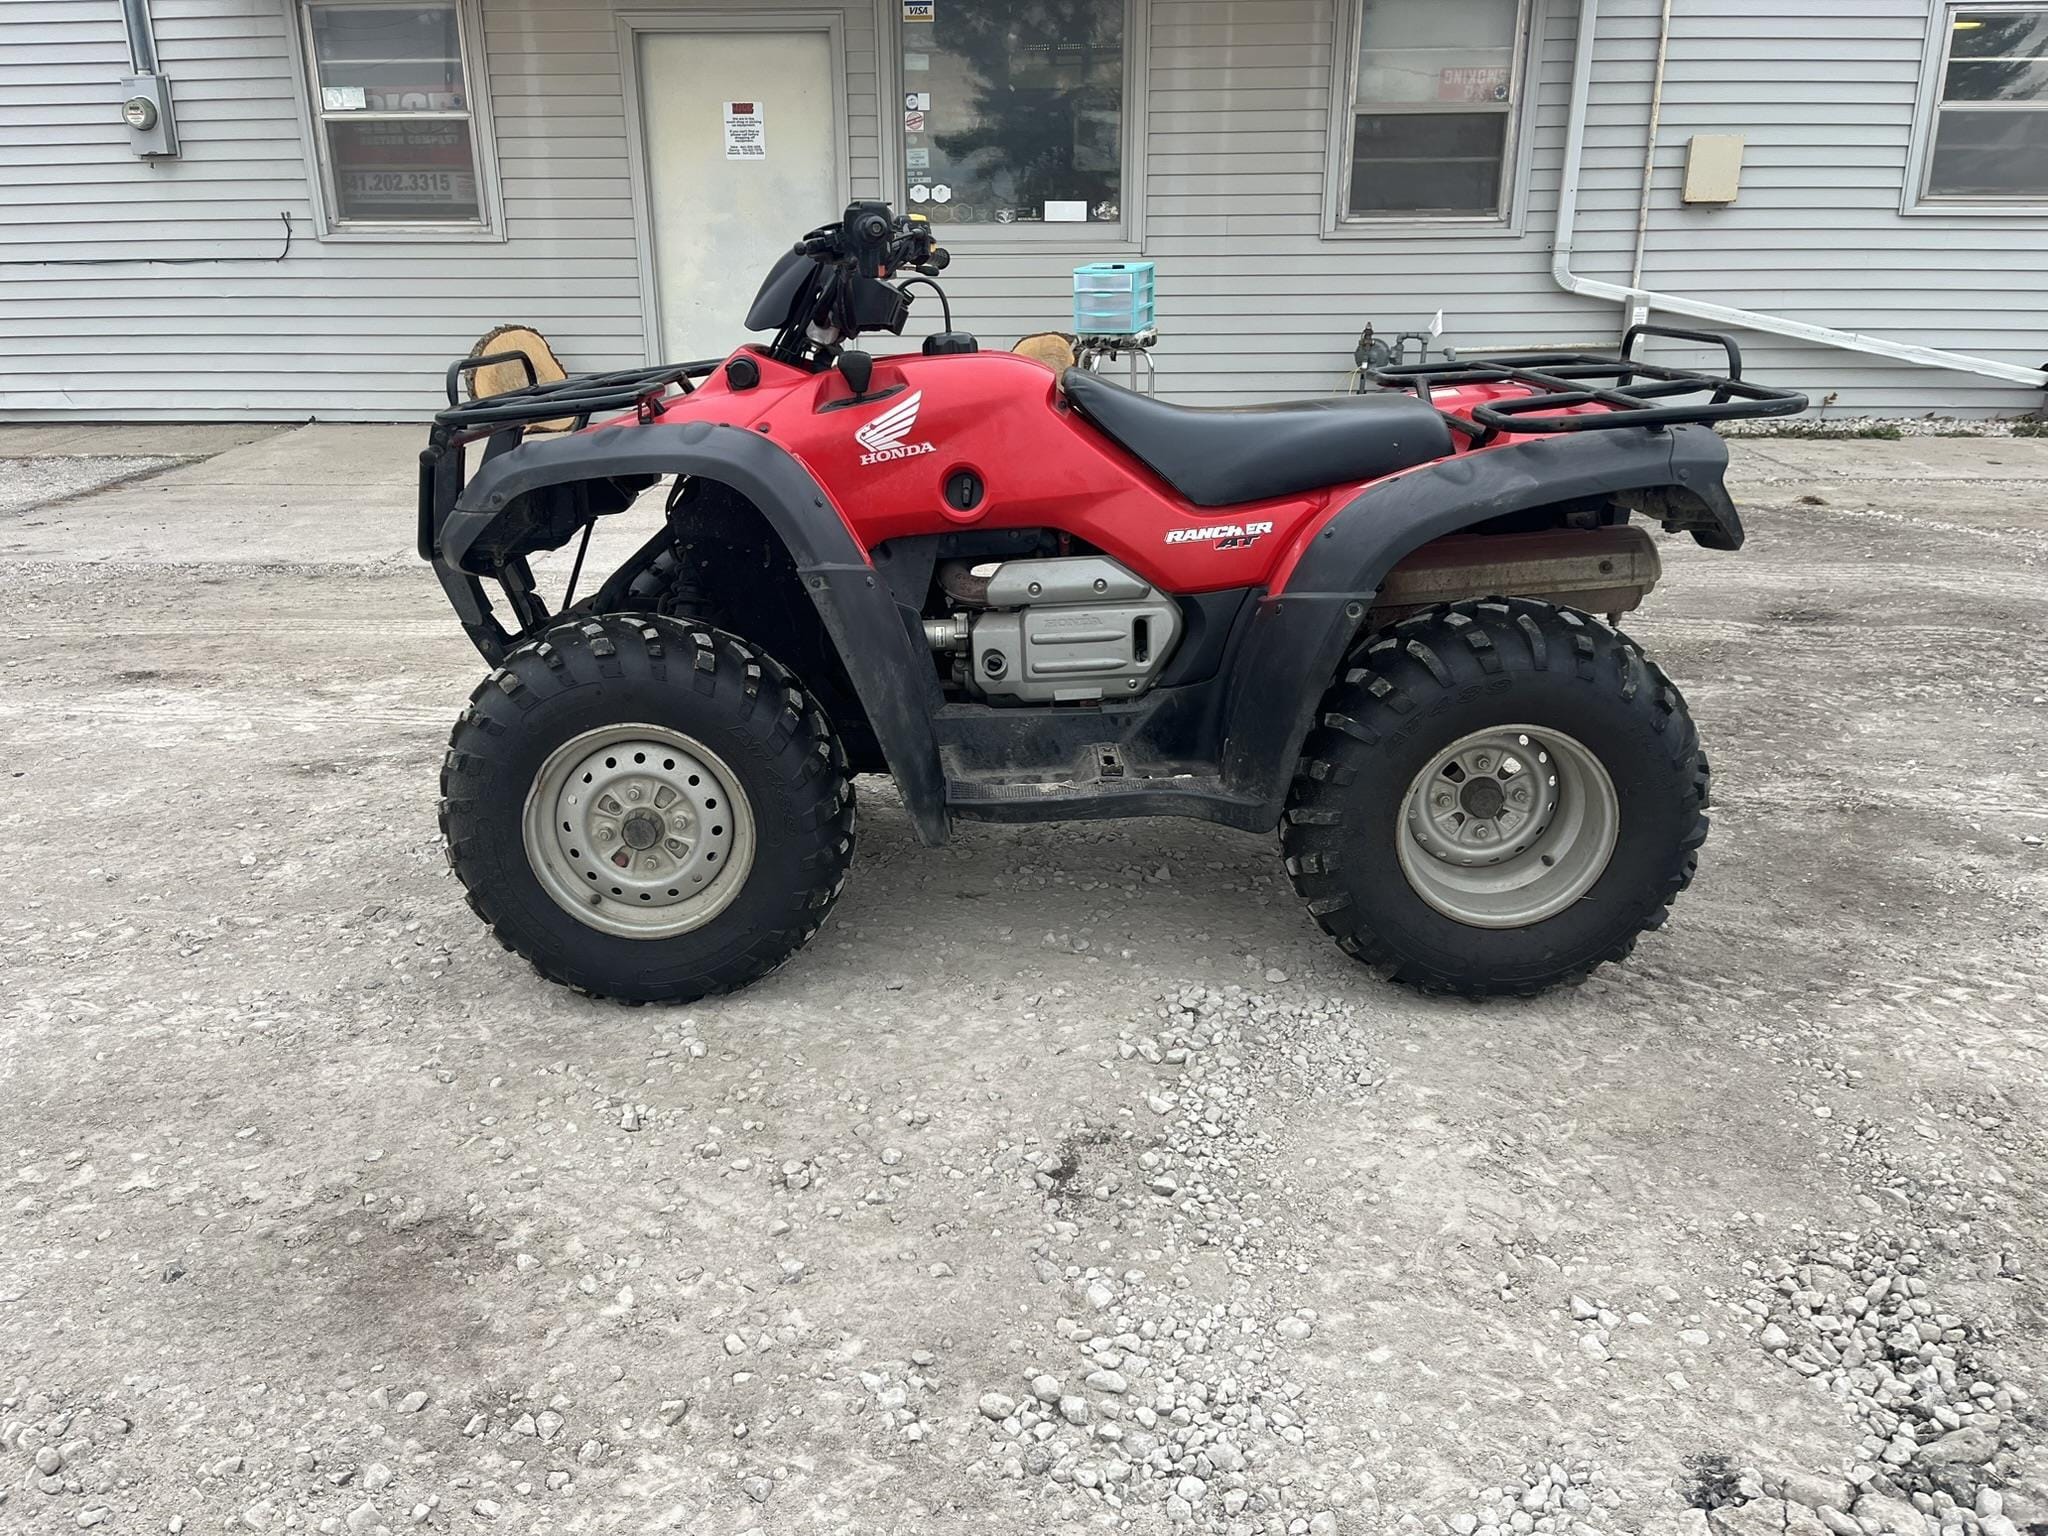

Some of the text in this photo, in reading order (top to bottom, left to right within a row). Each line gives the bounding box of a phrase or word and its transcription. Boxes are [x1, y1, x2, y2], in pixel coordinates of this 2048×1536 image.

[909, 6, 928, 15] VISA
[859, 441, 937, 466] HONDA
[1164, 521, 1273, 544] RANCHER
[1215, 534, 1261, 550] AT
[1043, 615, 1104, 628] HONDA
